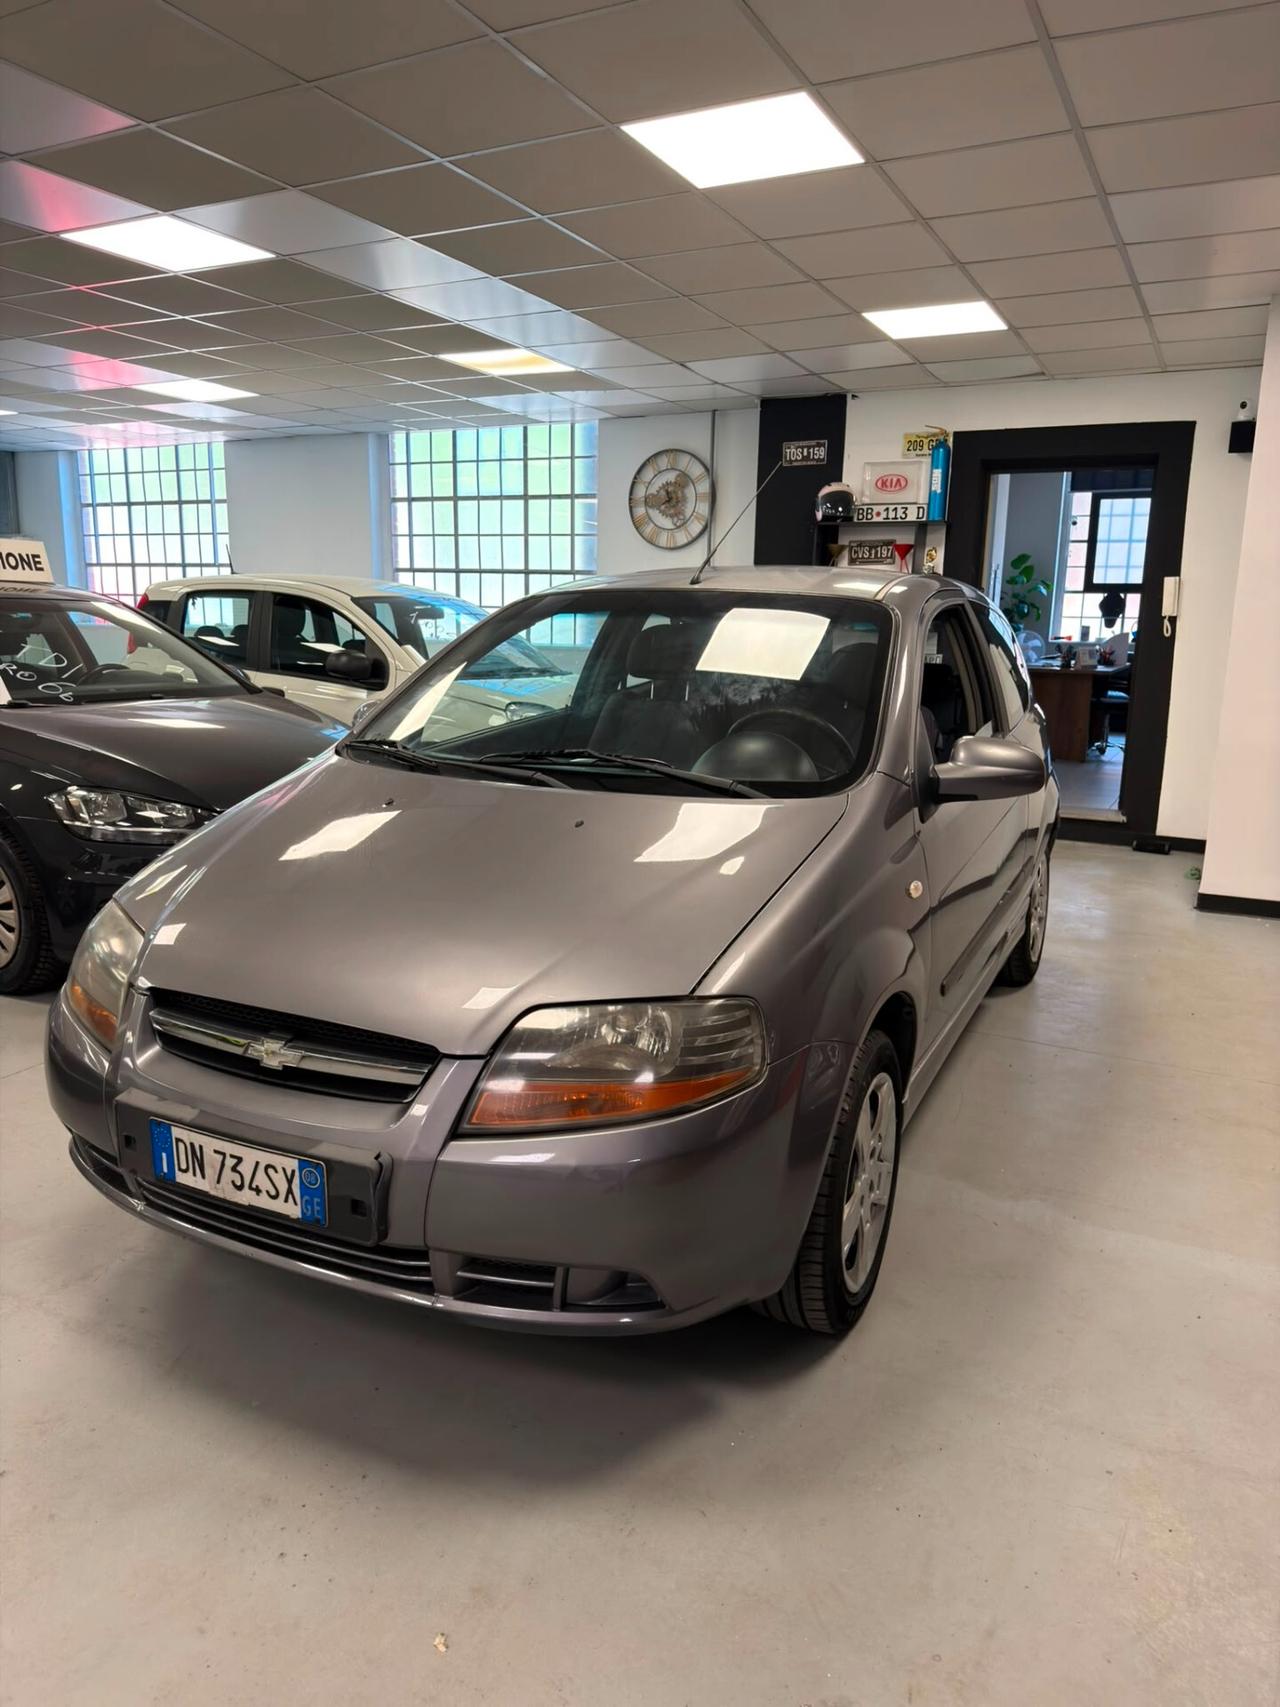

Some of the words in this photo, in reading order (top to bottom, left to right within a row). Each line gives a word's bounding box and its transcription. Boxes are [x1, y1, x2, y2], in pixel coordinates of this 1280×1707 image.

[906, 439, 924, 452] 209
[785, 447, 803, 461] TOS
[808, 446, 825, 460] 159
[880, 478, 903, 489] KIA
[856, 507, 874, 521] BB
[882, 506, 908, 521] 113
[915, 506, 926, 520] D
[851, 546, 870, 559] CVS
[876, 545, 893, 558] 197
[175, 1137, 206, 1180] DN
[213, 1149, 298, 1206] 734SX
[302, 1195, 321, 1218] GE
